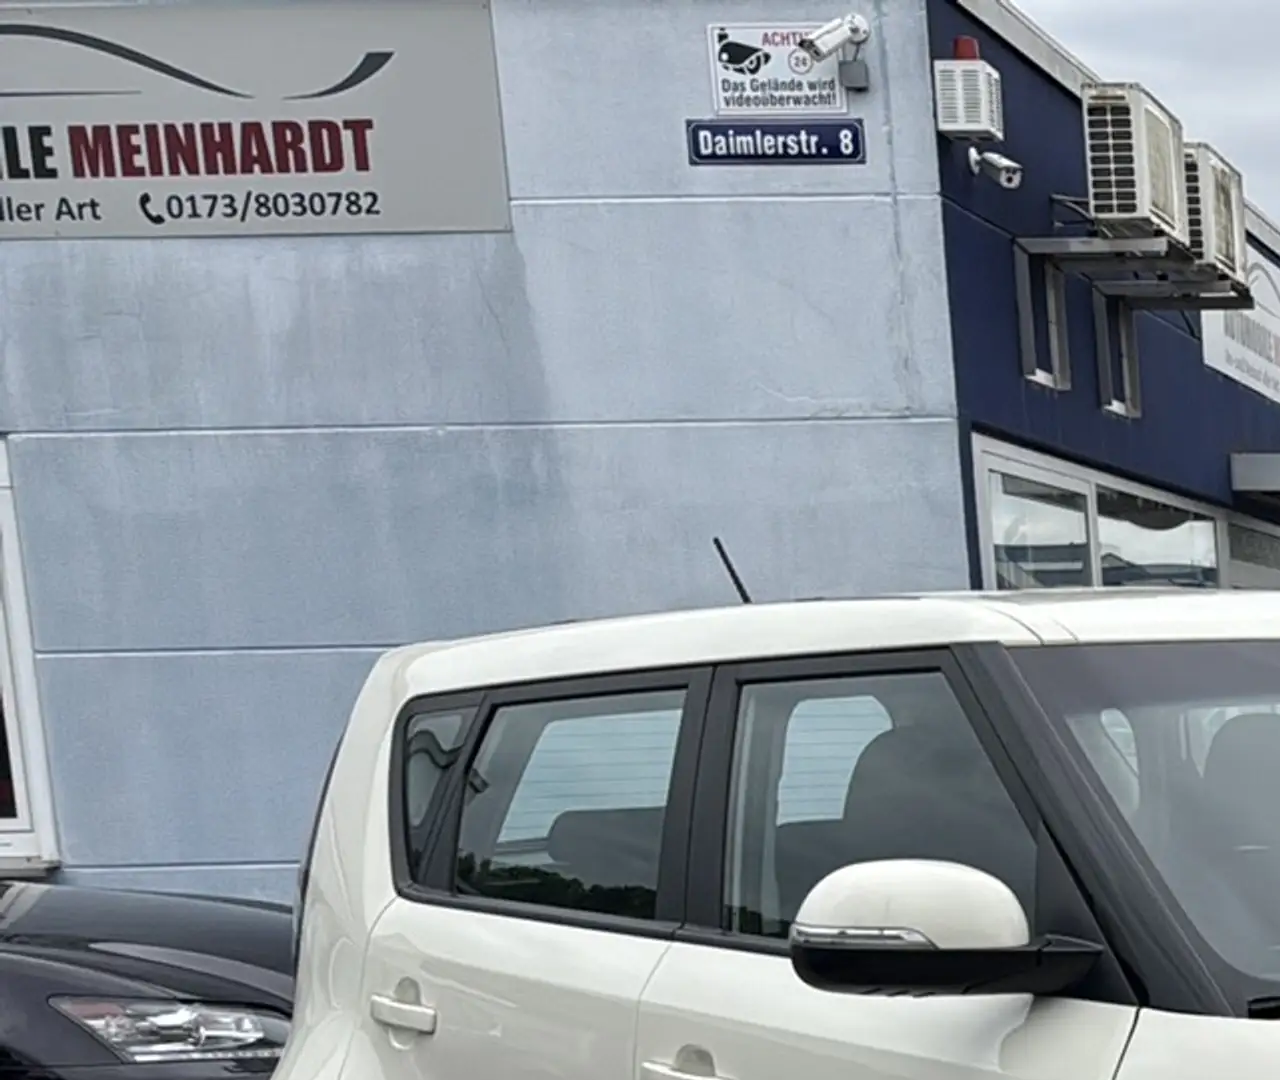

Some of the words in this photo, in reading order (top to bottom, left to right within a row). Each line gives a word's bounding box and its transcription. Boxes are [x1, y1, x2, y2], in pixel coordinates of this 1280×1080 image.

[721, 78, 746, 93] Das
[750, 77, 803, 93] Gelände
[807, 77, 836, 92] wird
[723, 92, 837, 107] videoüberwacht!
[0, 125, 58, 179] LE
[67, 119, 374, 179] MEINHARDT
[698, 129, 828, 156] Daimlerstr.
[839, 129, 853, 155] 8
[56, 196, 103, 221] Art
[166, 191, 382, 222] 0173/8030782
